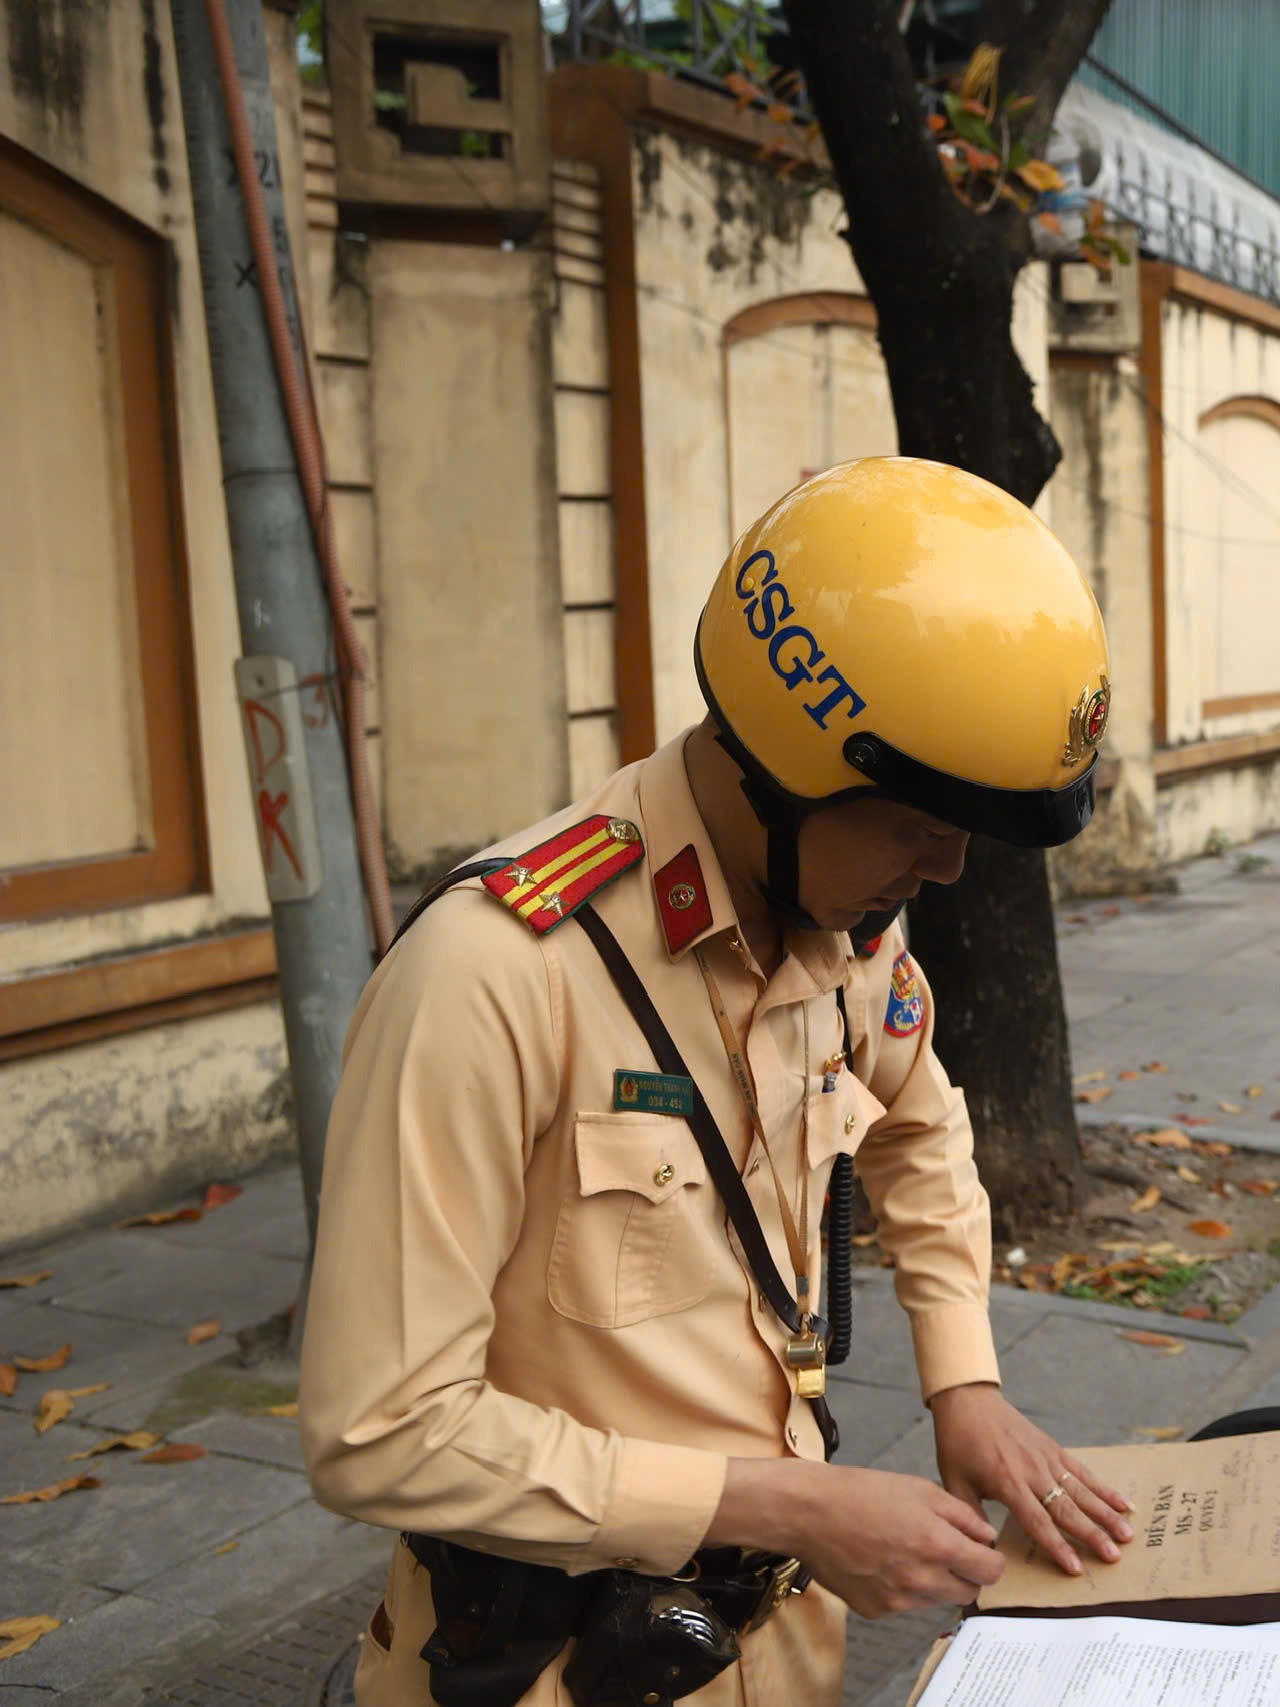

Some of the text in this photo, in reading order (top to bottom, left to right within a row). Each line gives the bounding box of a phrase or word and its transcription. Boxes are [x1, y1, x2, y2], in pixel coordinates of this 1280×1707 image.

[735, 549, 867, 731] CSGT
[1181, 1492, 1199, 1505] 27
[1174, 1514, 1195, 1536] MS
